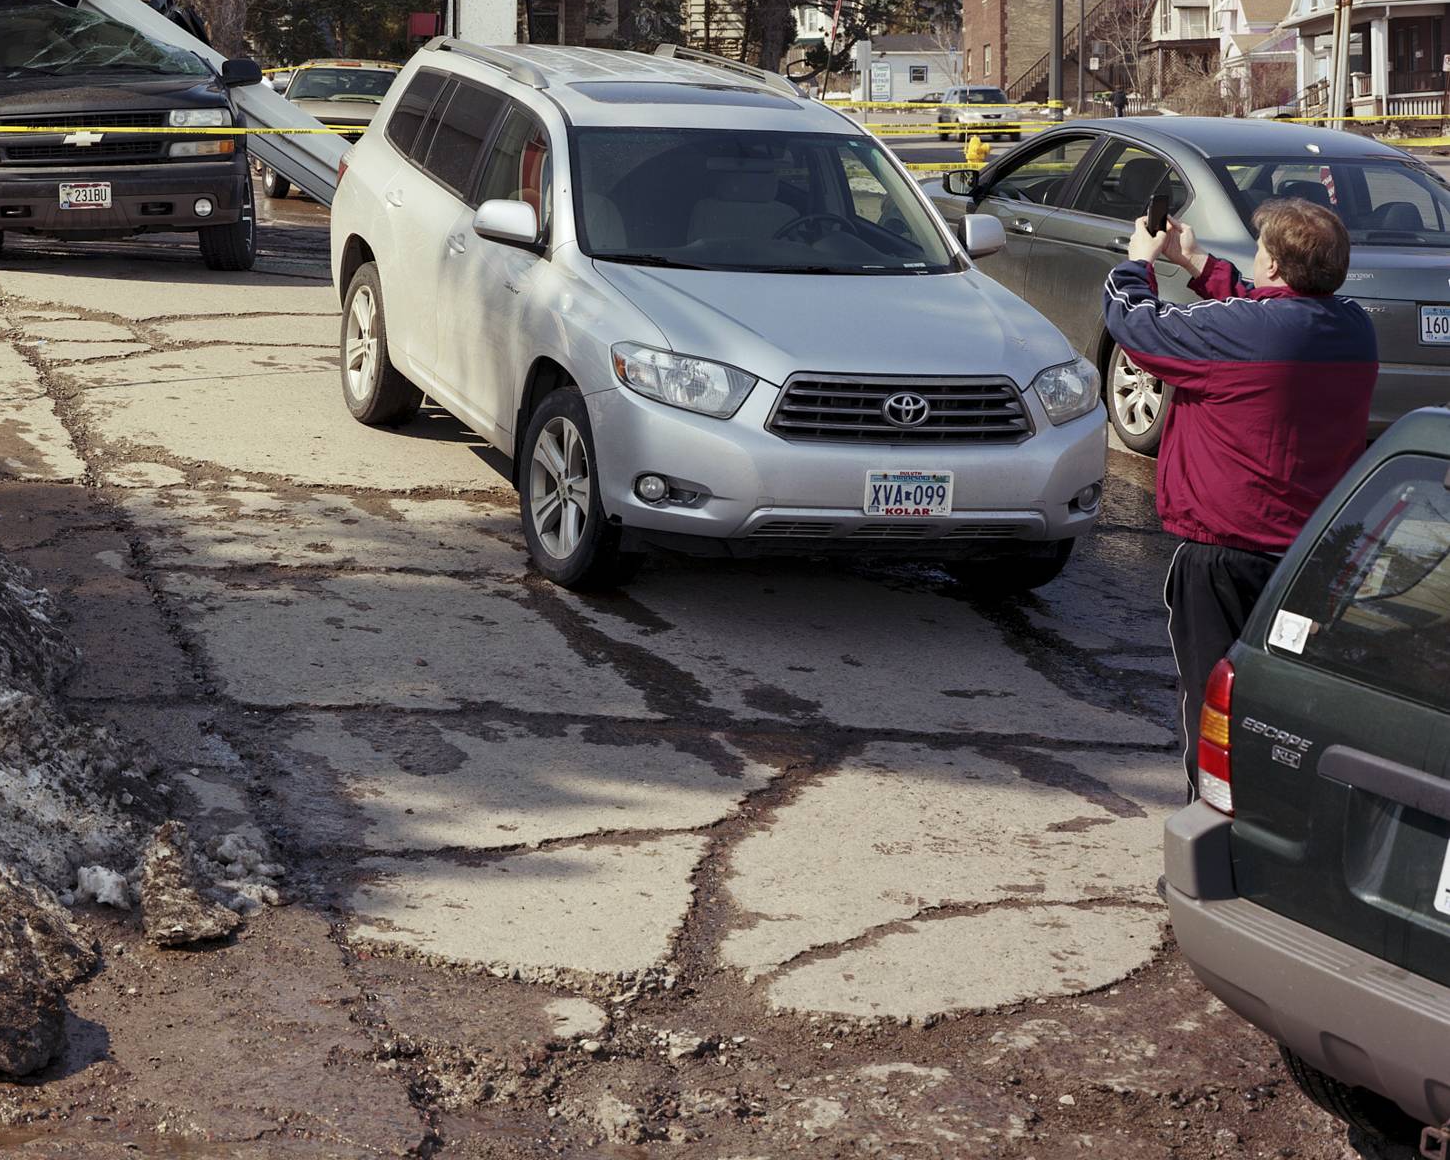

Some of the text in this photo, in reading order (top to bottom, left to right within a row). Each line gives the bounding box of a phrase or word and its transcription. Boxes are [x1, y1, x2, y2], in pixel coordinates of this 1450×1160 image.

[74, 188, 107, 202] 231BU
[1425, 316, 1449, 334] 160
[1241, 716, 1314, 752] ESCAPE
[1274, 747, 1299, 767] XLT
